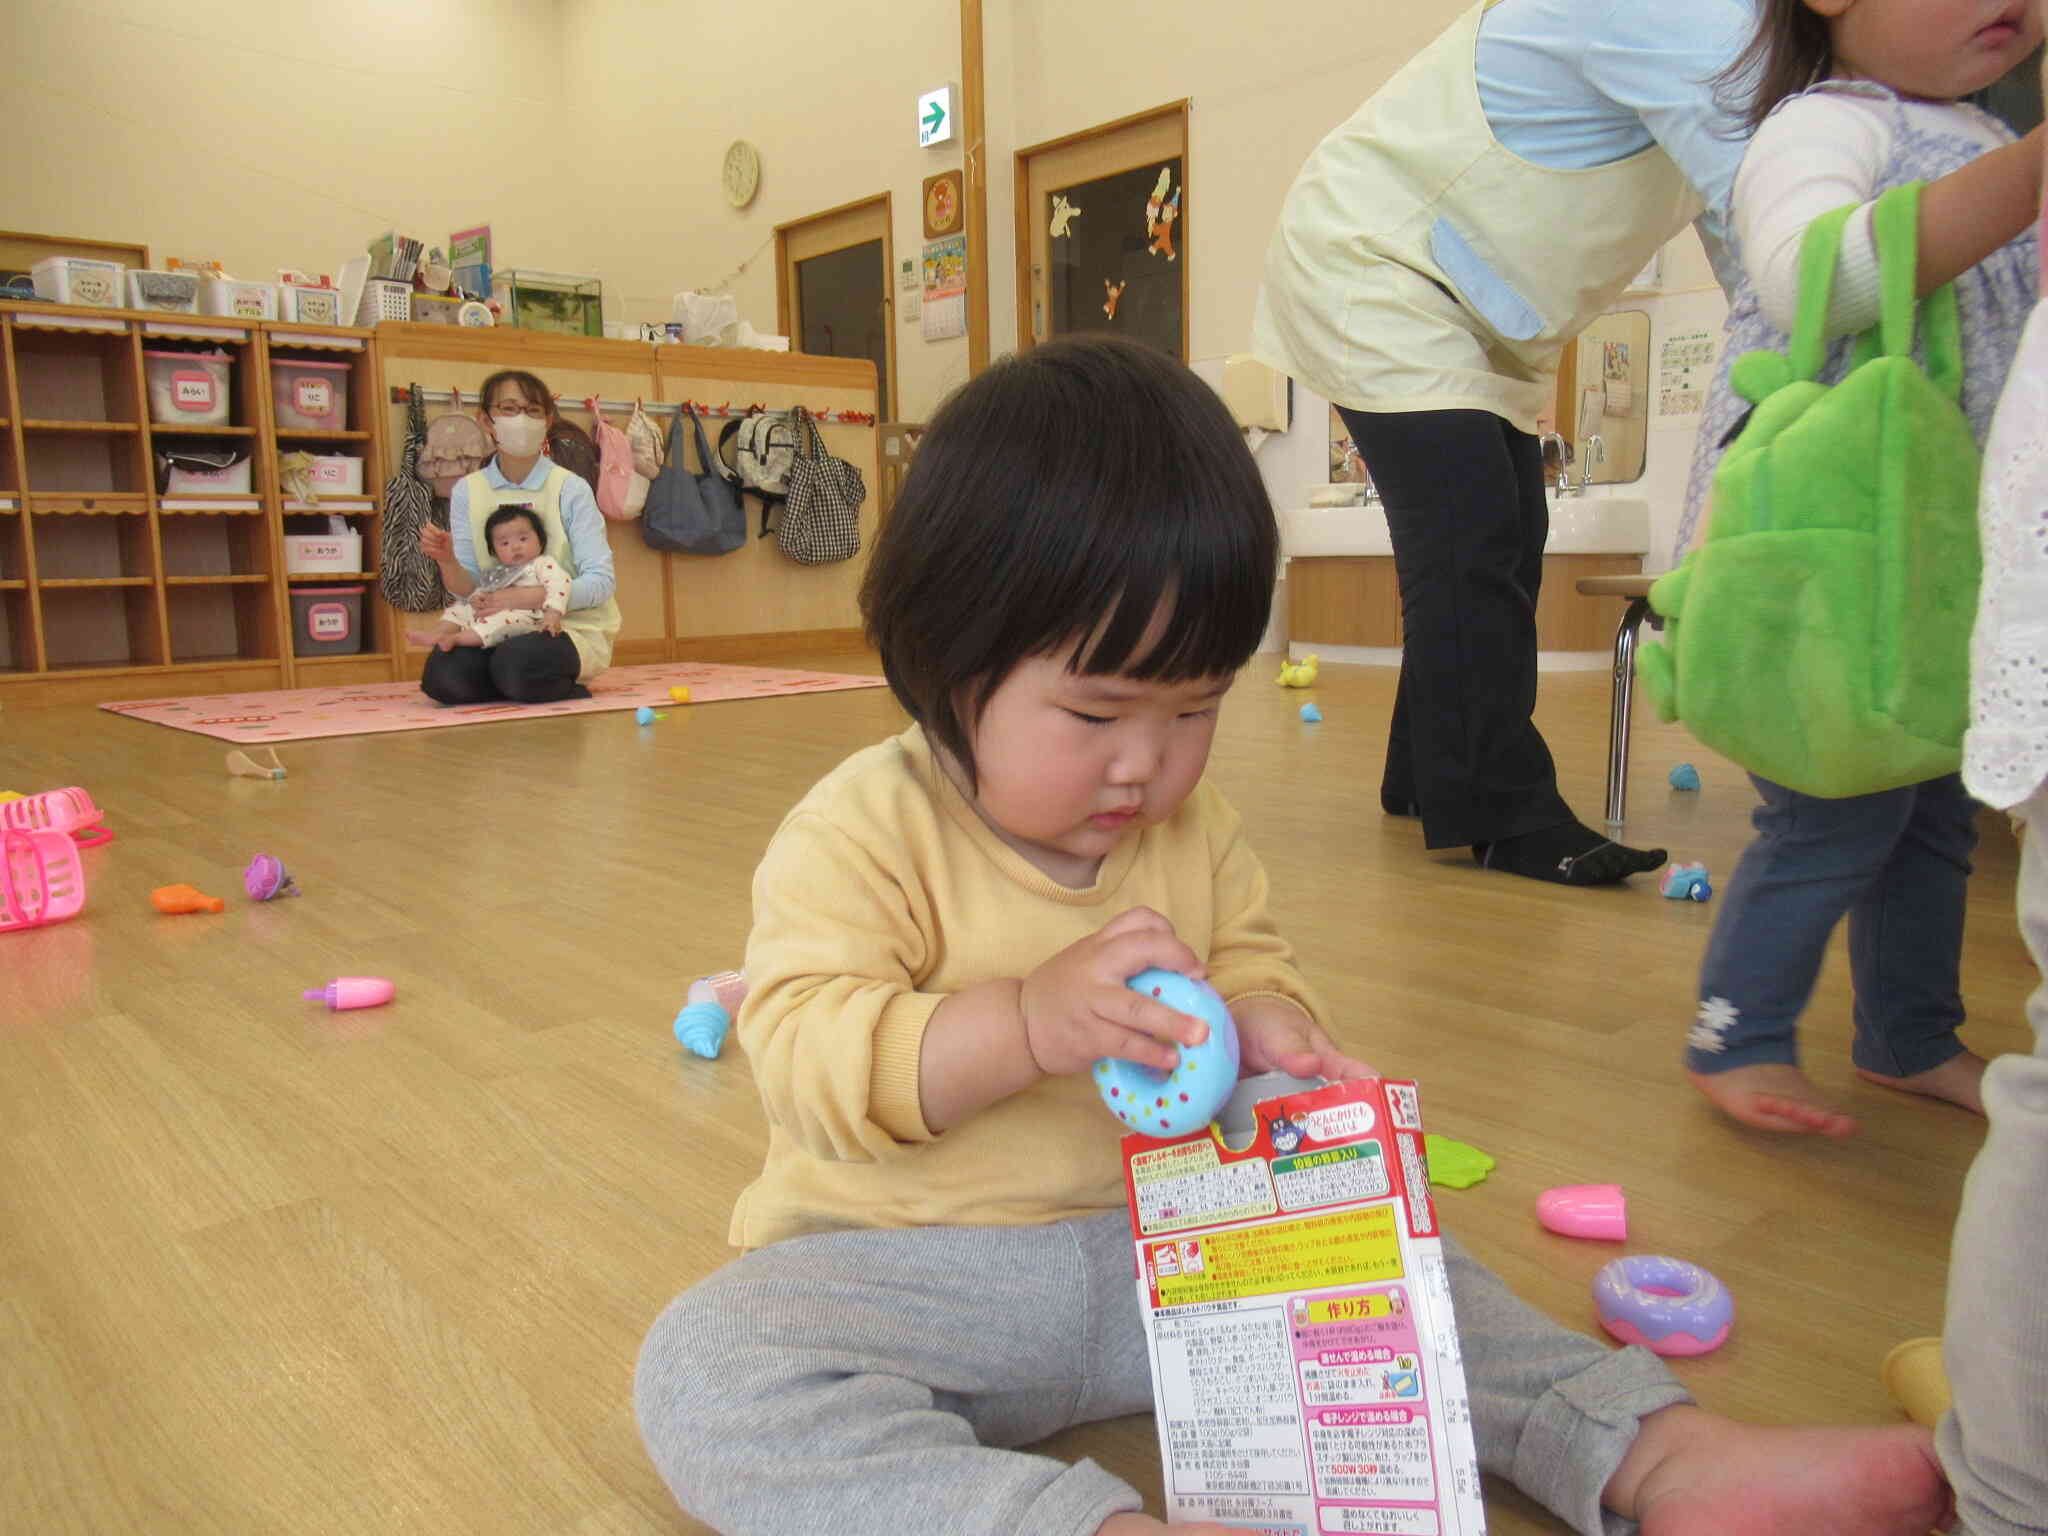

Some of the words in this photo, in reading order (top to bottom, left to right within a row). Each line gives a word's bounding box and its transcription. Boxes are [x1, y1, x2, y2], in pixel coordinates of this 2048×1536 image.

[1328, 1300, 1371, 1319] 作り方
[1322, 1410, 1408, 1424] 電子レンジで温める場合
